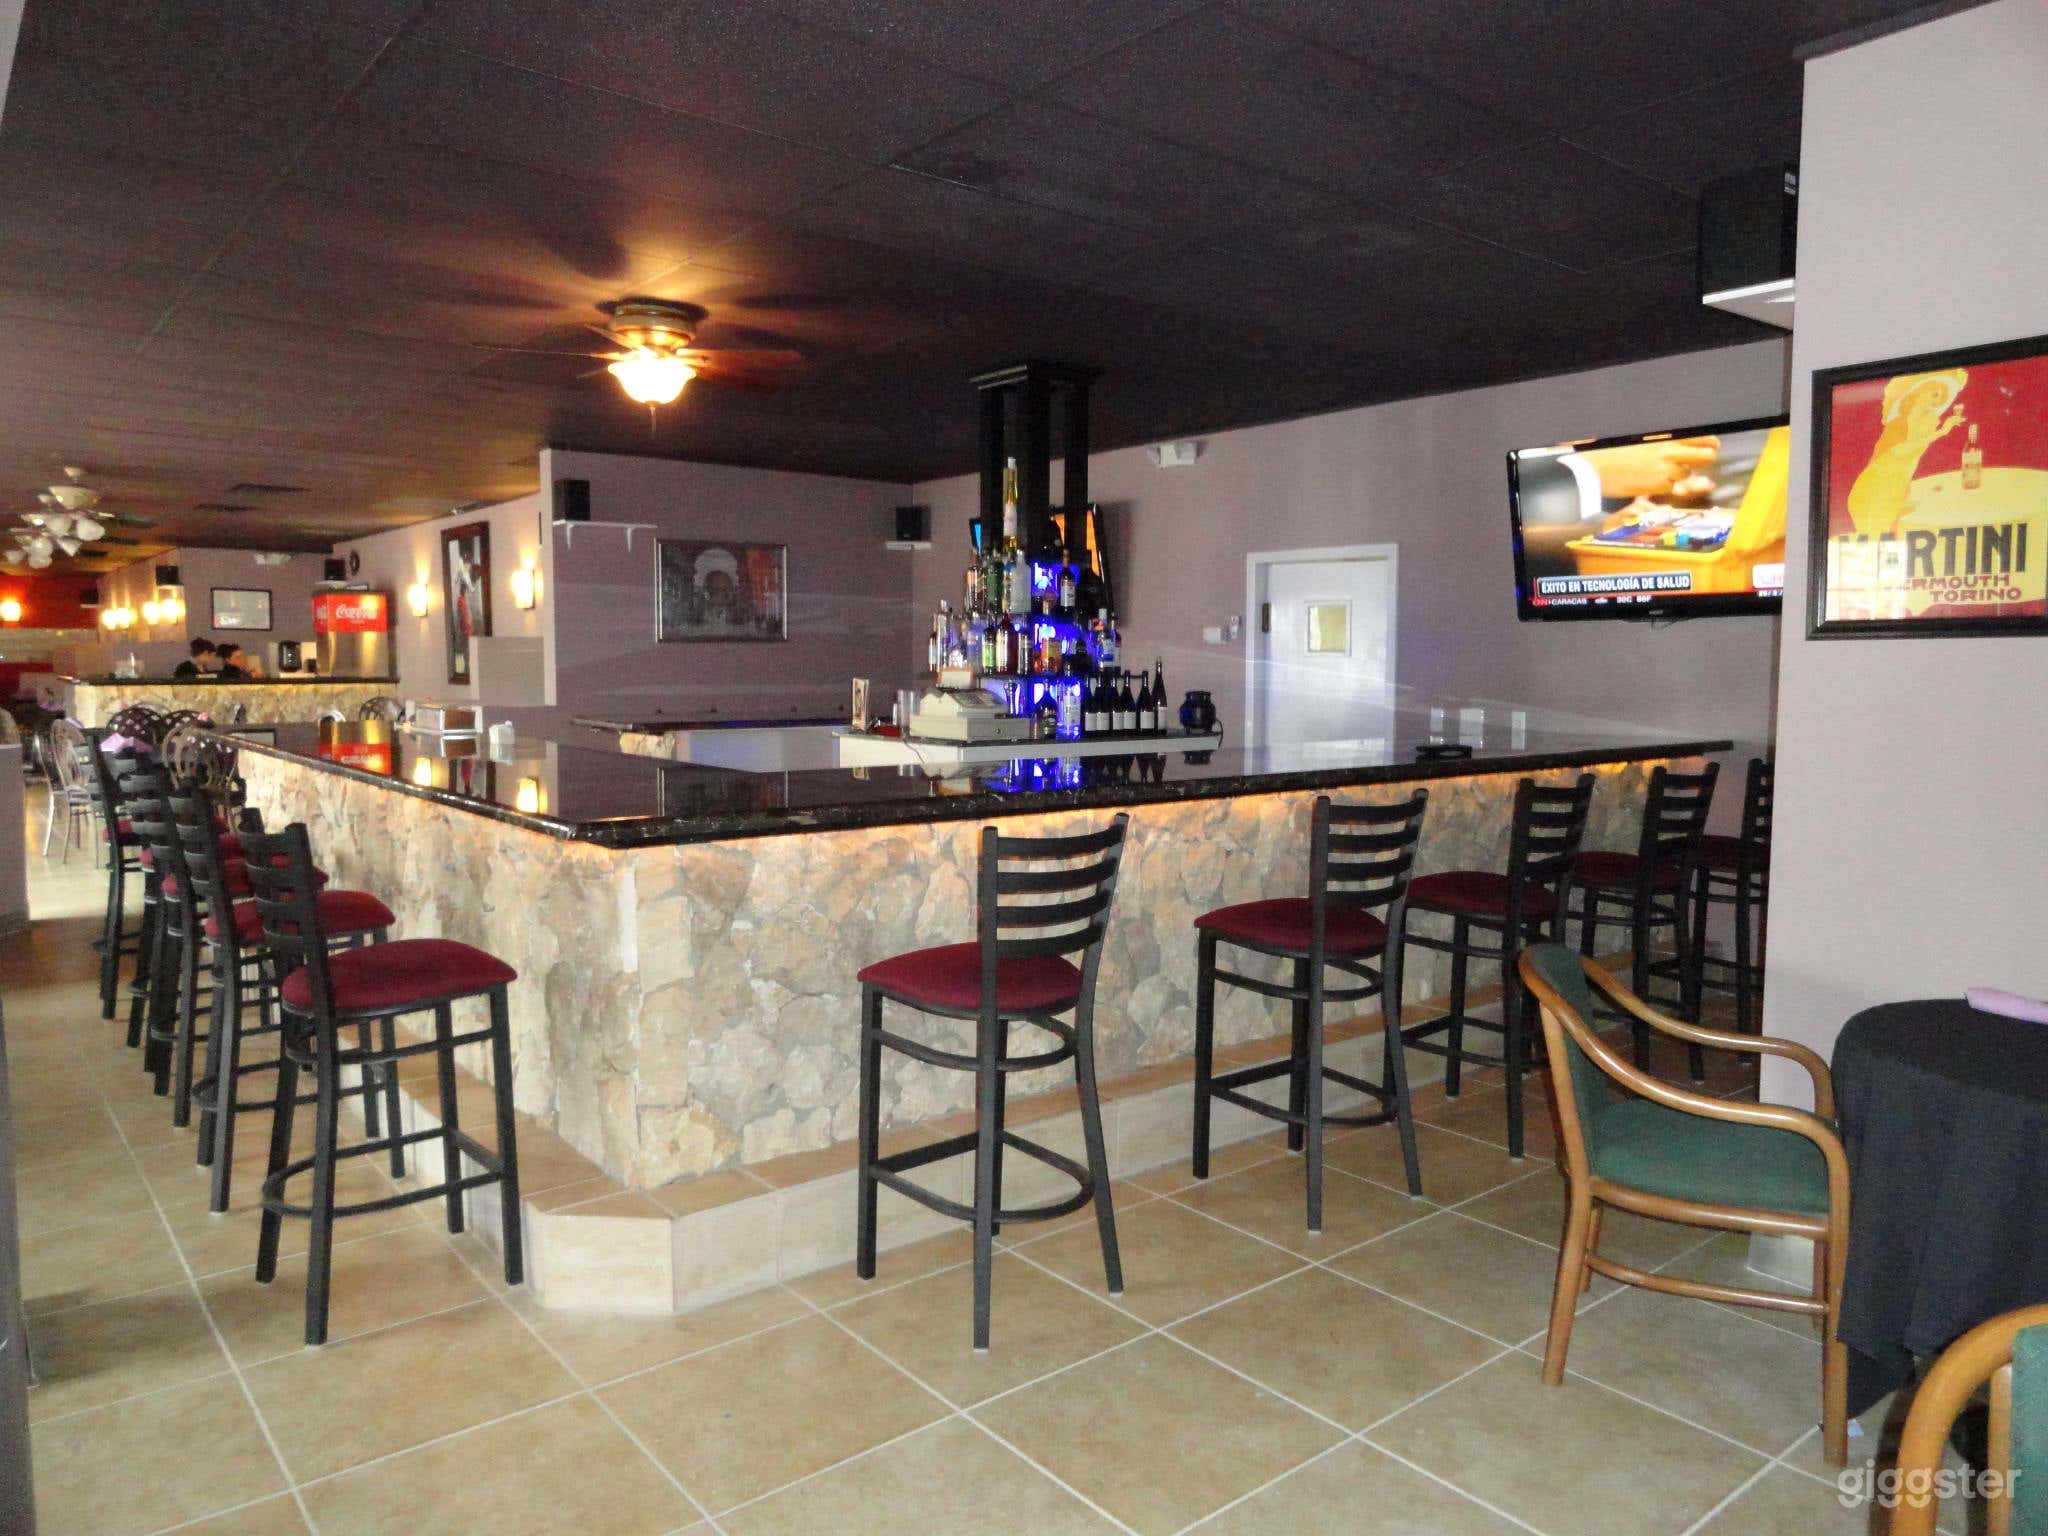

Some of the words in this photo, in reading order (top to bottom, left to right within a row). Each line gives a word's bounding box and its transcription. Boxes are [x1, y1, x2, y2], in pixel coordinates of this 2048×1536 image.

[1838, 522, 2028, 578] RTINI
[1568, 581, 1580, 593] EN
[1641, 577, 1655, 590] DE
[1656, 575, 1690, 588] SALUD
[1895, 574, 2010, 591] RMOUTH
[1929, 587, 2022, 602] TORINO
